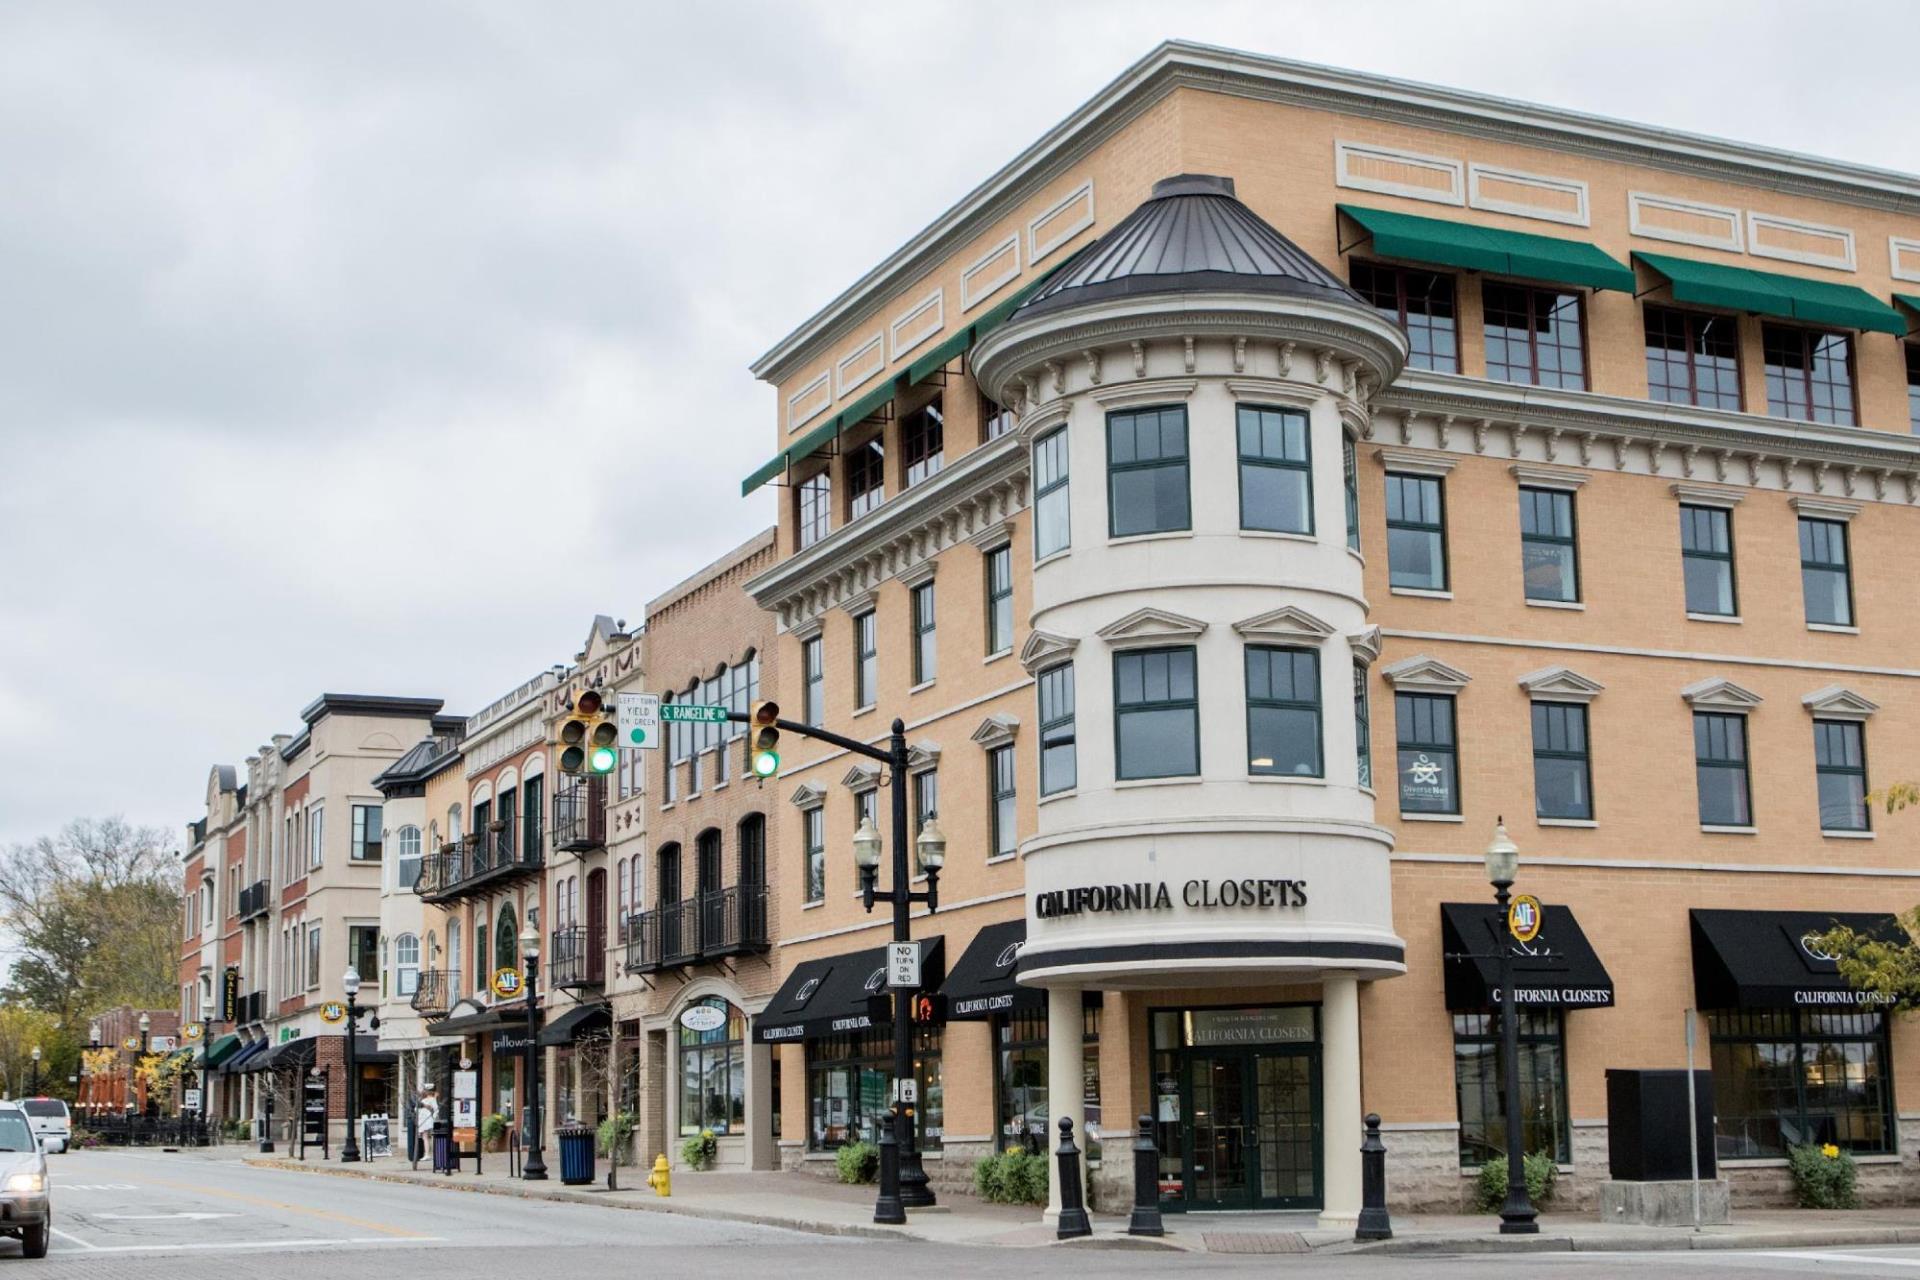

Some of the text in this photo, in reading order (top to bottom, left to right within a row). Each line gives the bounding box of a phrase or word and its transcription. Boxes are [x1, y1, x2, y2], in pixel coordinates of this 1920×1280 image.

[627, 706, 650, 716] YIELD
[673, 707, 716, 721] RANGELINE
[717, 710, 726, 719] RD
[634, 718, 656, 726] GREEN
[1036, 879, 1308, 919] CALIFORNIA CLOSETS
[896, 946, 911, 956] NO
[896, 957, 914, 965] TURN
[1492, 988, 1609, 1003] CIFORNIA CLOSETS
[1794, 991, 1854, 1004] CALIFORNIA
[956, 995, 1014, 1014] CALIFORNIA CLOSETS
[1259, 1026, 1309, 1040] CLOSETS
